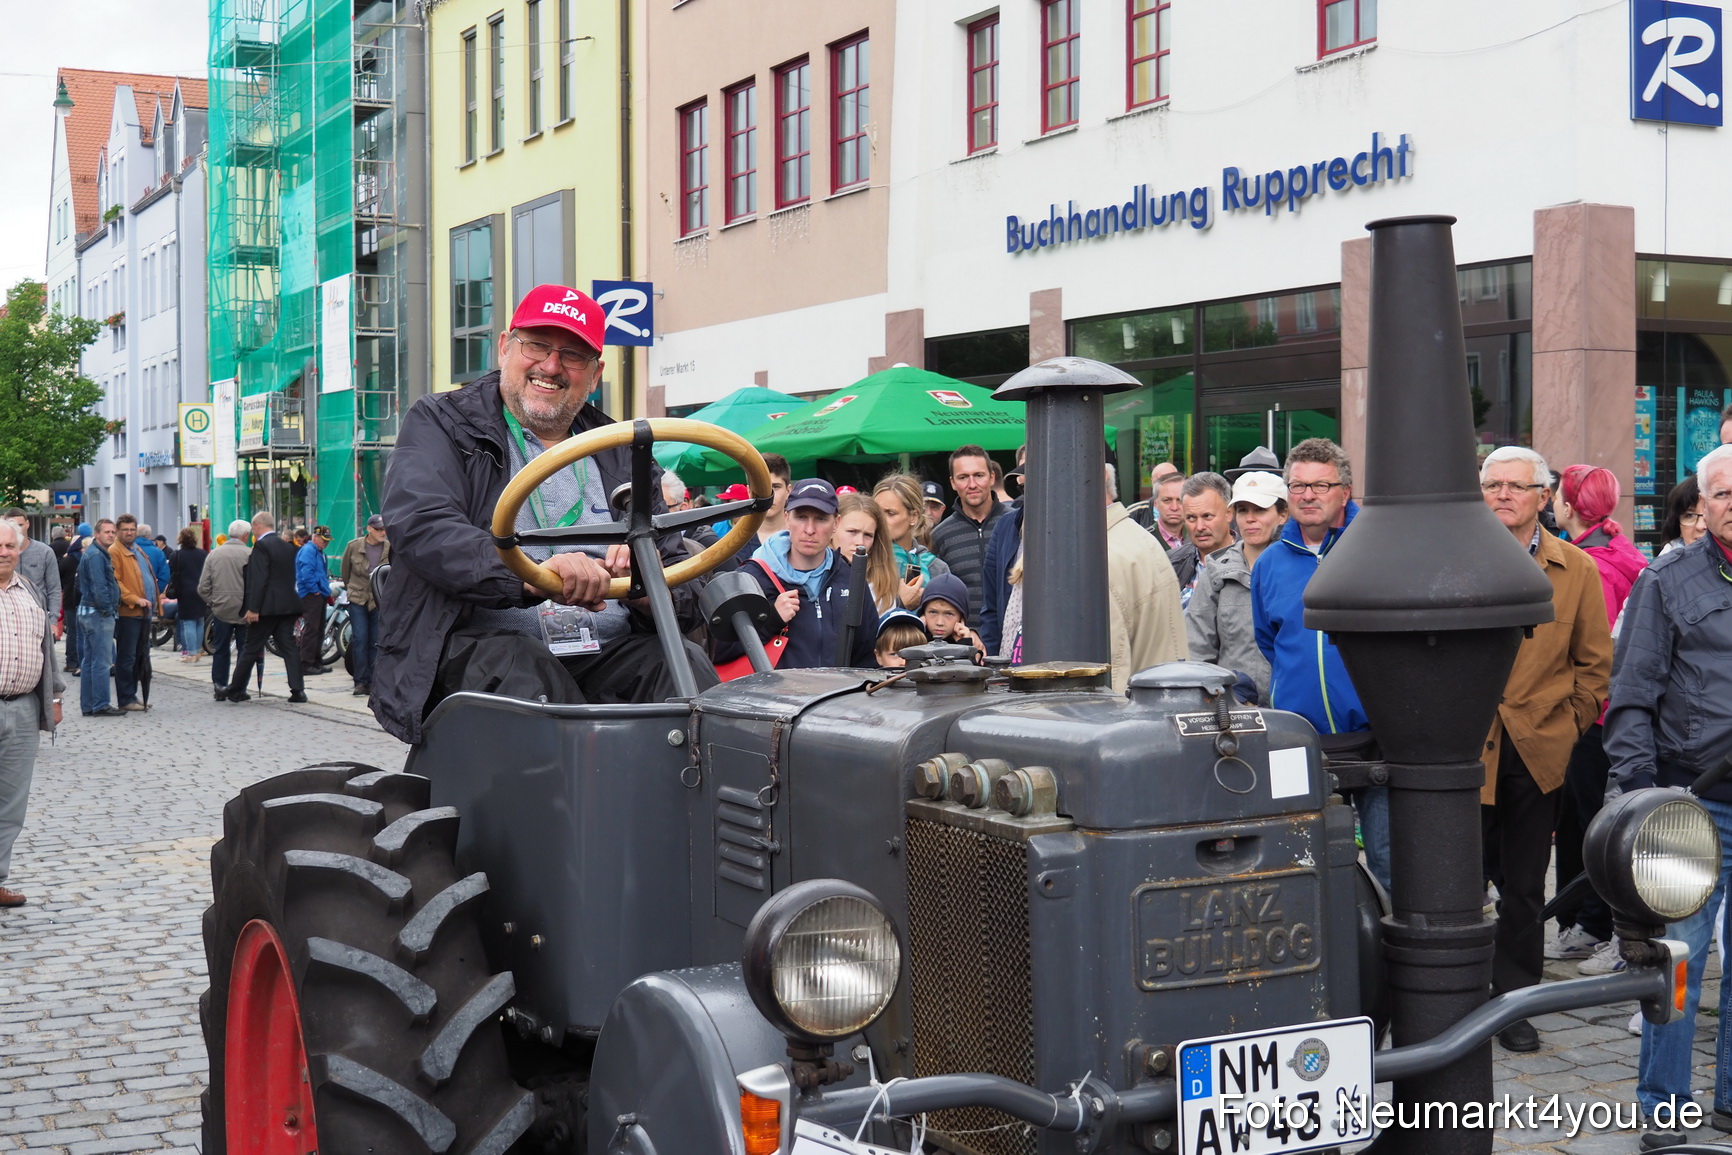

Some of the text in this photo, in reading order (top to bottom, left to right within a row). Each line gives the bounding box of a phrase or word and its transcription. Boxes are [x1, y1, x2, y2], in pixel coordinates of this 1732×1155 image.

[1642, 17, 1719, 108] R.
[1006, 132, 1412, 253] Buchhandlung Rupprecht
[543, 302, 587, 326] DEKRA
[1694, 389, 1714, 398] PAULA
[1689, 398, 1720, 407] HAWKINS
[192, 413, 203, 428] H
[924, 417, 1026, 426] Lammsbrä
[1693, 418, 1714, 427] INTO
[1696, 430, 1711, 439] THE
[1179, 883, 1283, 932] LANZ
[1146, 922, 1313, 979] BULLDOG
[1219, 1041, 1279, 1095] NM
[1192, 1079, 1203, 1096] D
